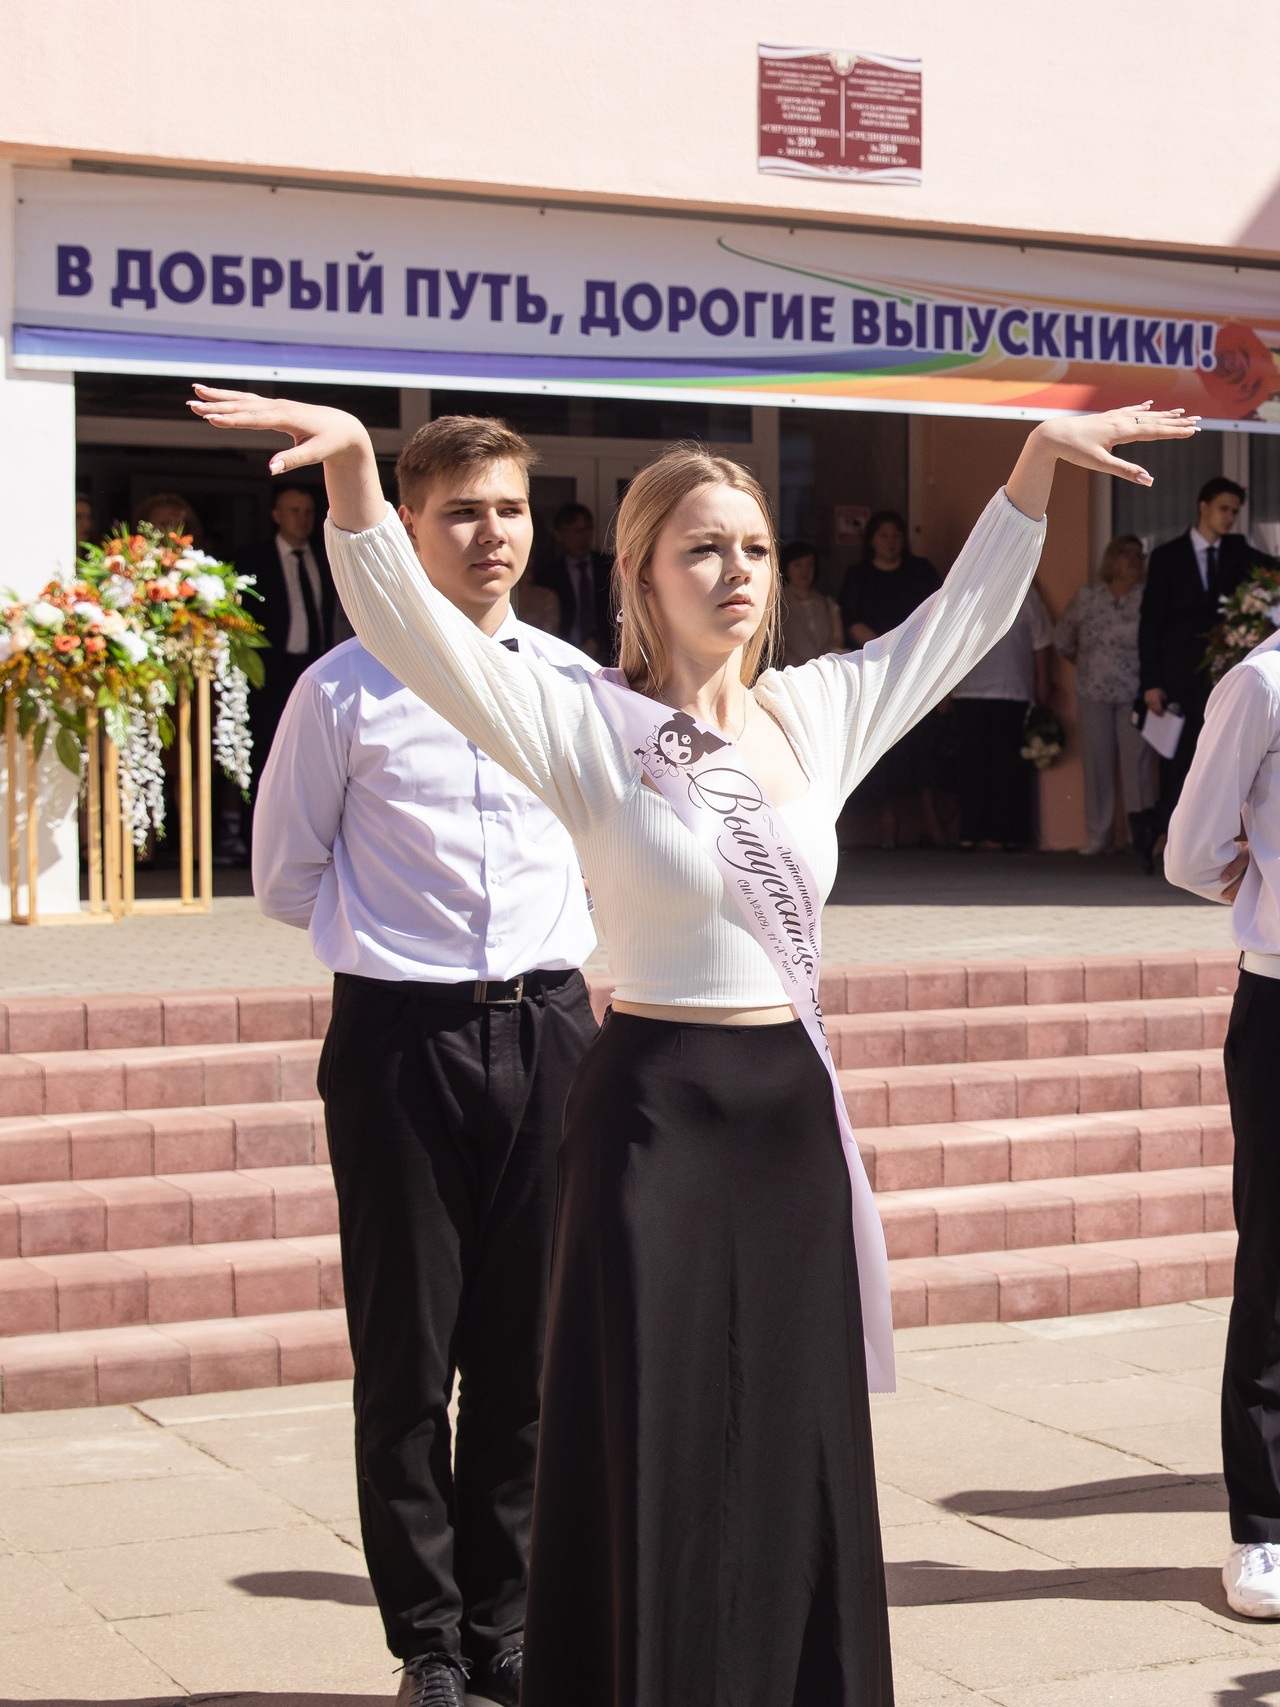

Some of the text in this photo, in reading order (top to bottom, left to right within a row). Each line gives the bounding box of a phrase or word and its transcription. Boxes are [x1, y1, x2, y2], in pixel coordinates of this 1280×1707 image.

[796, 135, 817, 148] 209
[878, 142, 898, 155] 209
[56, 244, 1215, 369] В ДОБРЫЙ ПУТЬ, ДОРОГИЕ ВЫПУСКНИКИ!
[686, 767, 815, 980] Выпускница
[776, 845, 814, 919] Литвинович
[781, 960, 799, 986] класс
